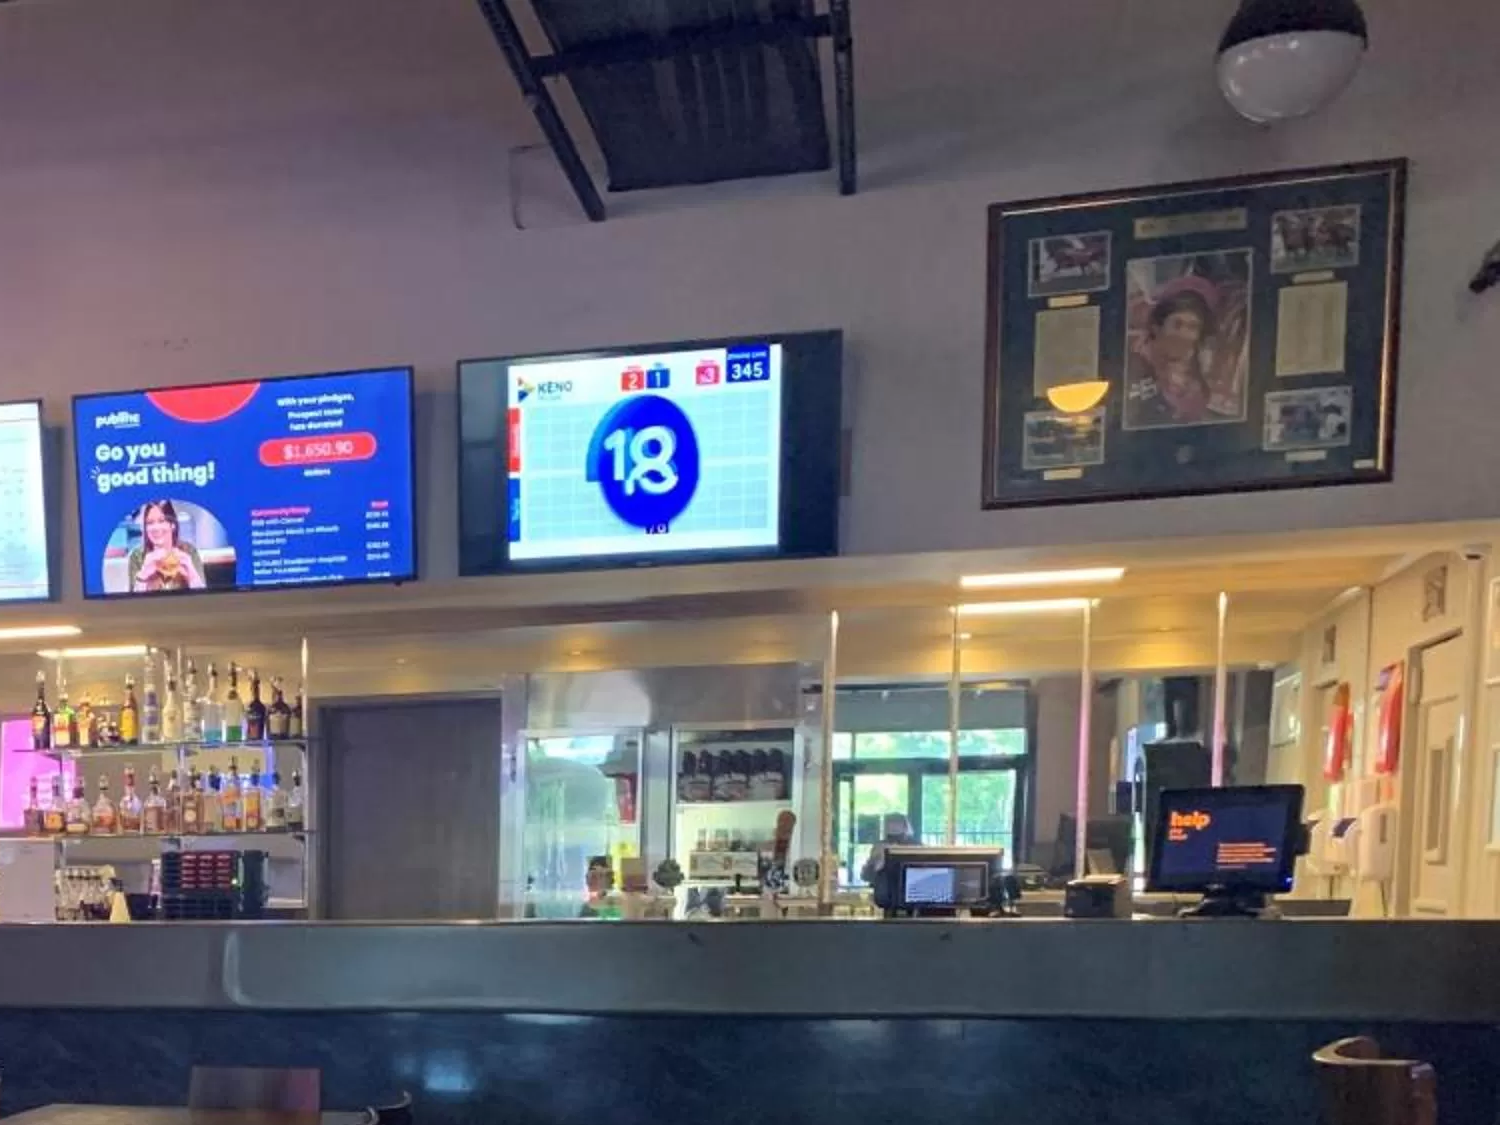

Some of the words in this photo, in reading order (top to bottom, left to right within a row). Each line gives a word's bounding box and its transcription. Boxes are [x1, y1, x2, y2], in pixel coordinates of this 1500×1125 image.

[731, 361, 763, 380] 345
[95, 443, 125, 463] Go
[124, 441, 166, 468] you
[603, 424, 679, 497] 18
[97, 466, 149, 495] good
[151, 459, 216, 488] thing!
[1171, 811, 1211, 831] help
